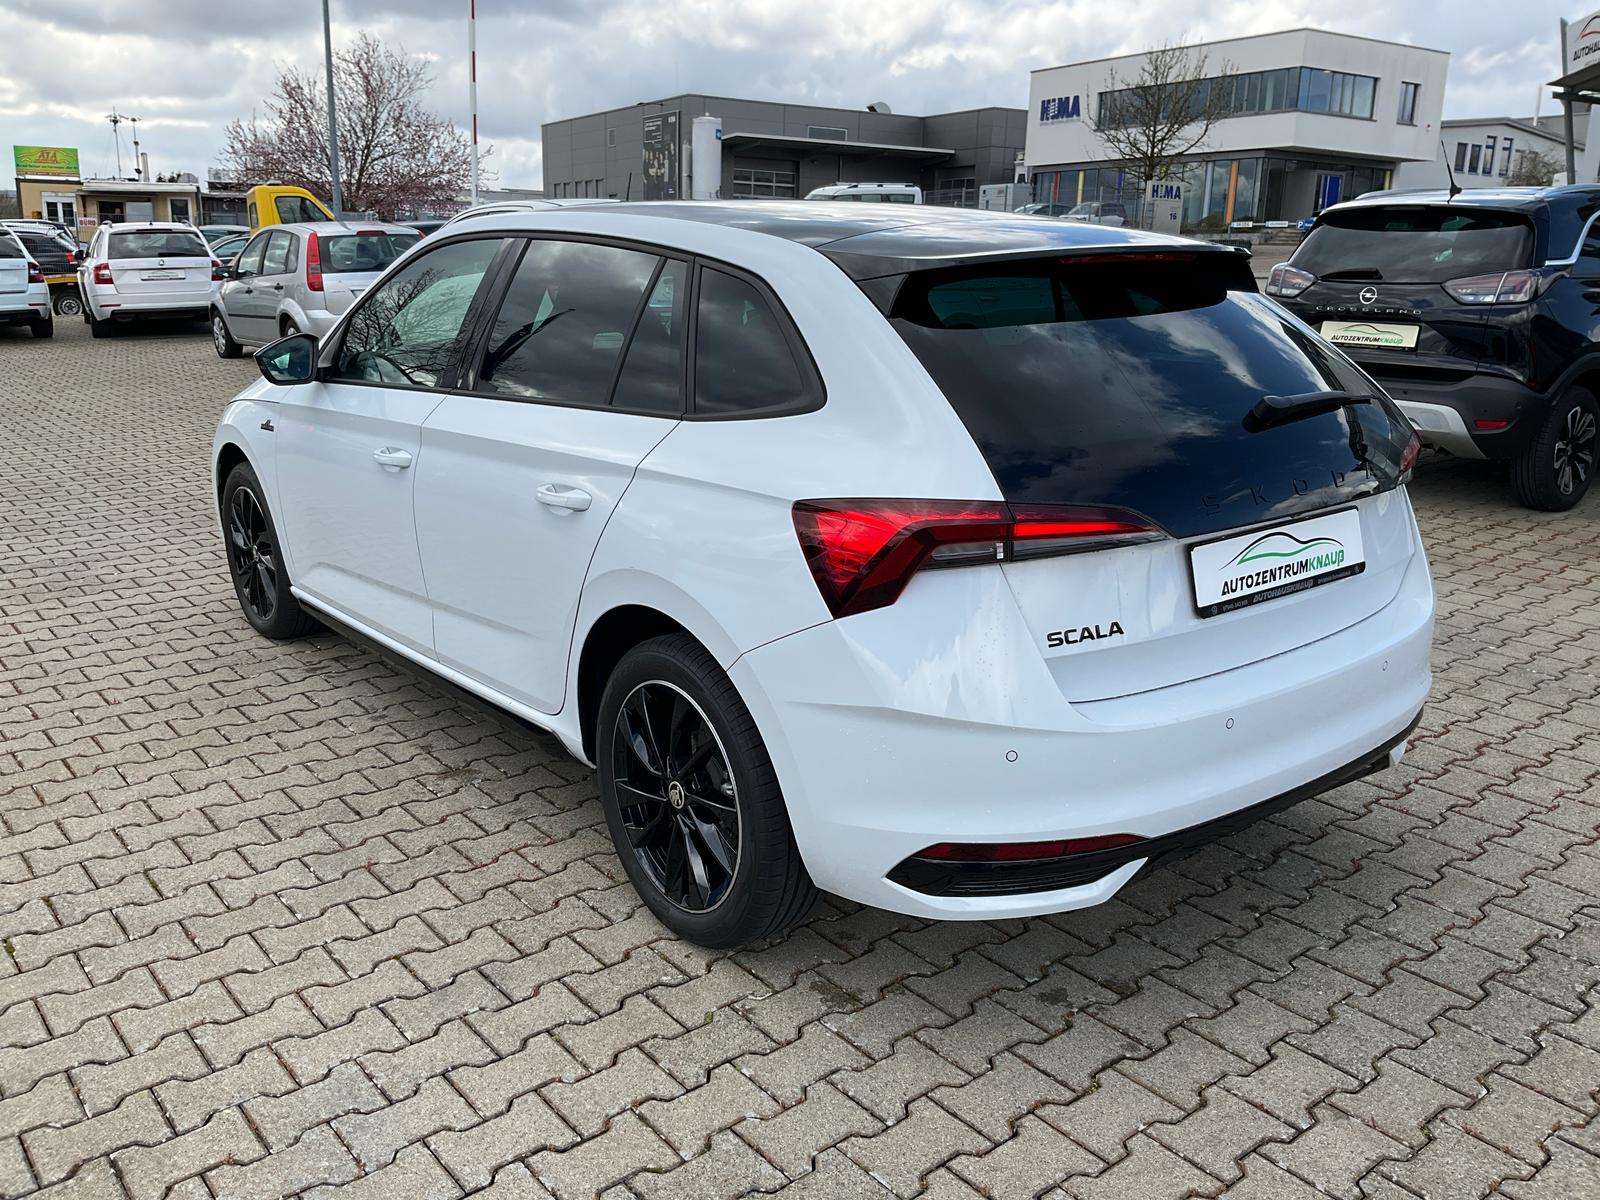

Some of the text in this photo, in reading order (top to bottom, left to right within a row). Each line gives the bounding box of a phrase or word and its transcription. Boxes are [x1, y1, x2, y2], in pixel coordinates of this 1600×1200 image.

[1040, 95, 1080, 121] HIMA
[1152, 184, 1181, 199] HIMA
[1316, 305, 1421, 315] CROSSLAND
[1046, 621, 1125, 648] SCALA
